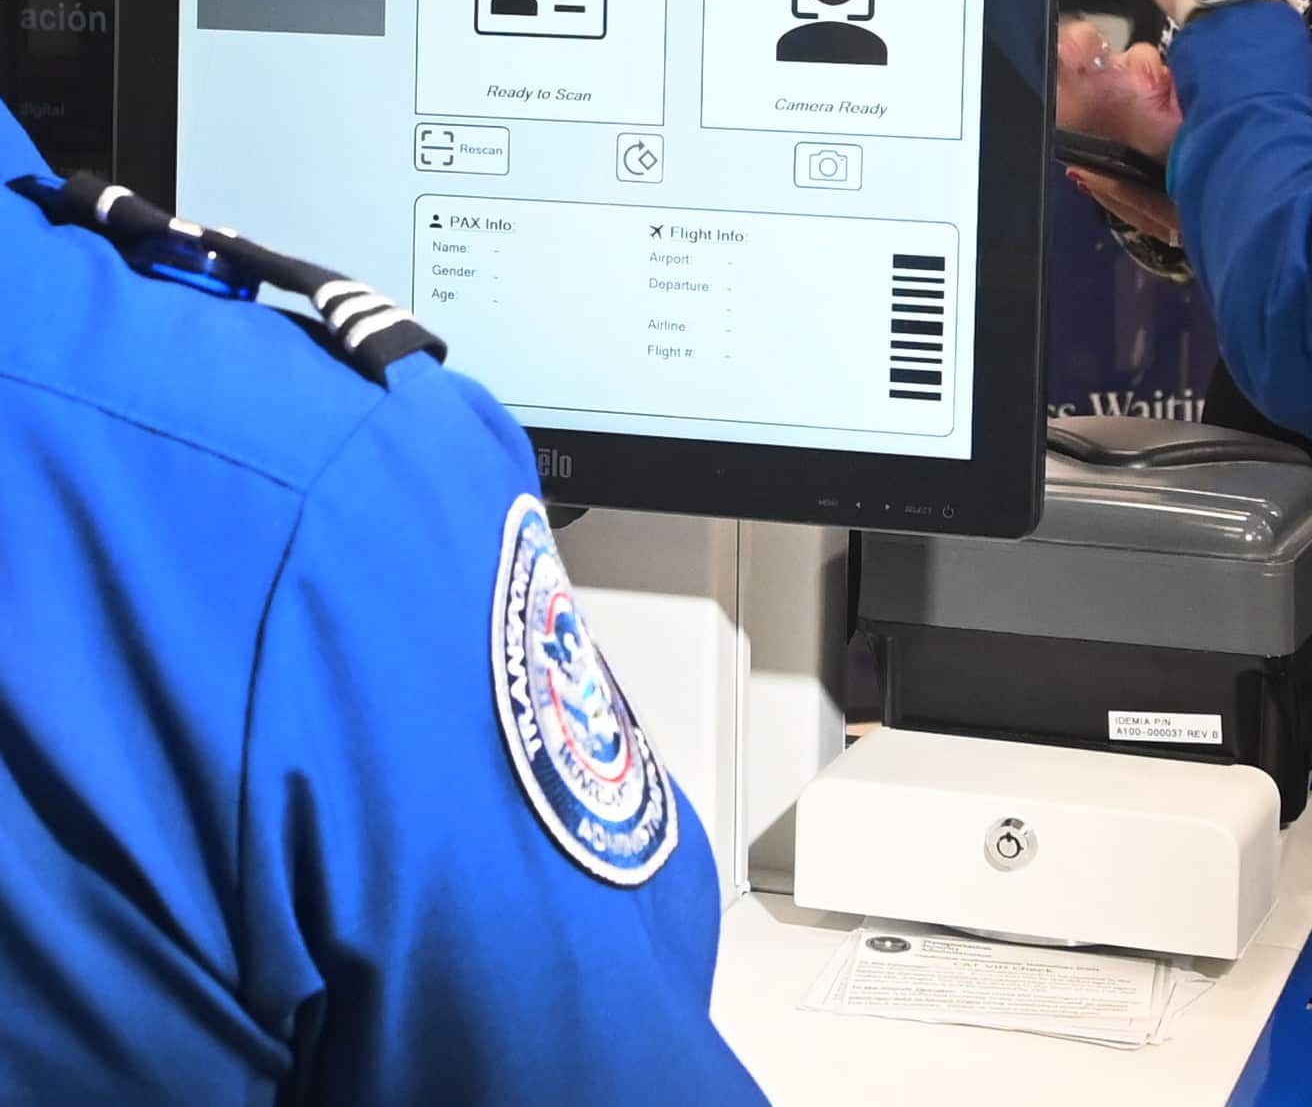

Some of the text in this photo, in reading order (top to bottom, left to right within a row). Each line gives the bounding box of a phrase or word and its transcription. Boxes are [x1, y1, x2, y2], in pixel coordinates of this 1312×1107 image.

[487, 85, 592, 103] Ready to Scan
[774, 99, 888, 118] Camera Ready
[459, 143, 504, 157] Rescan
[449, 216, 481, 231] PAX
[670, 225, 713, 243] Flight
[647, 345, 682, 360] Flight
[1114, 716, 1150, 726] IDEMIA
[1187, 729, 1208, 739] REV
